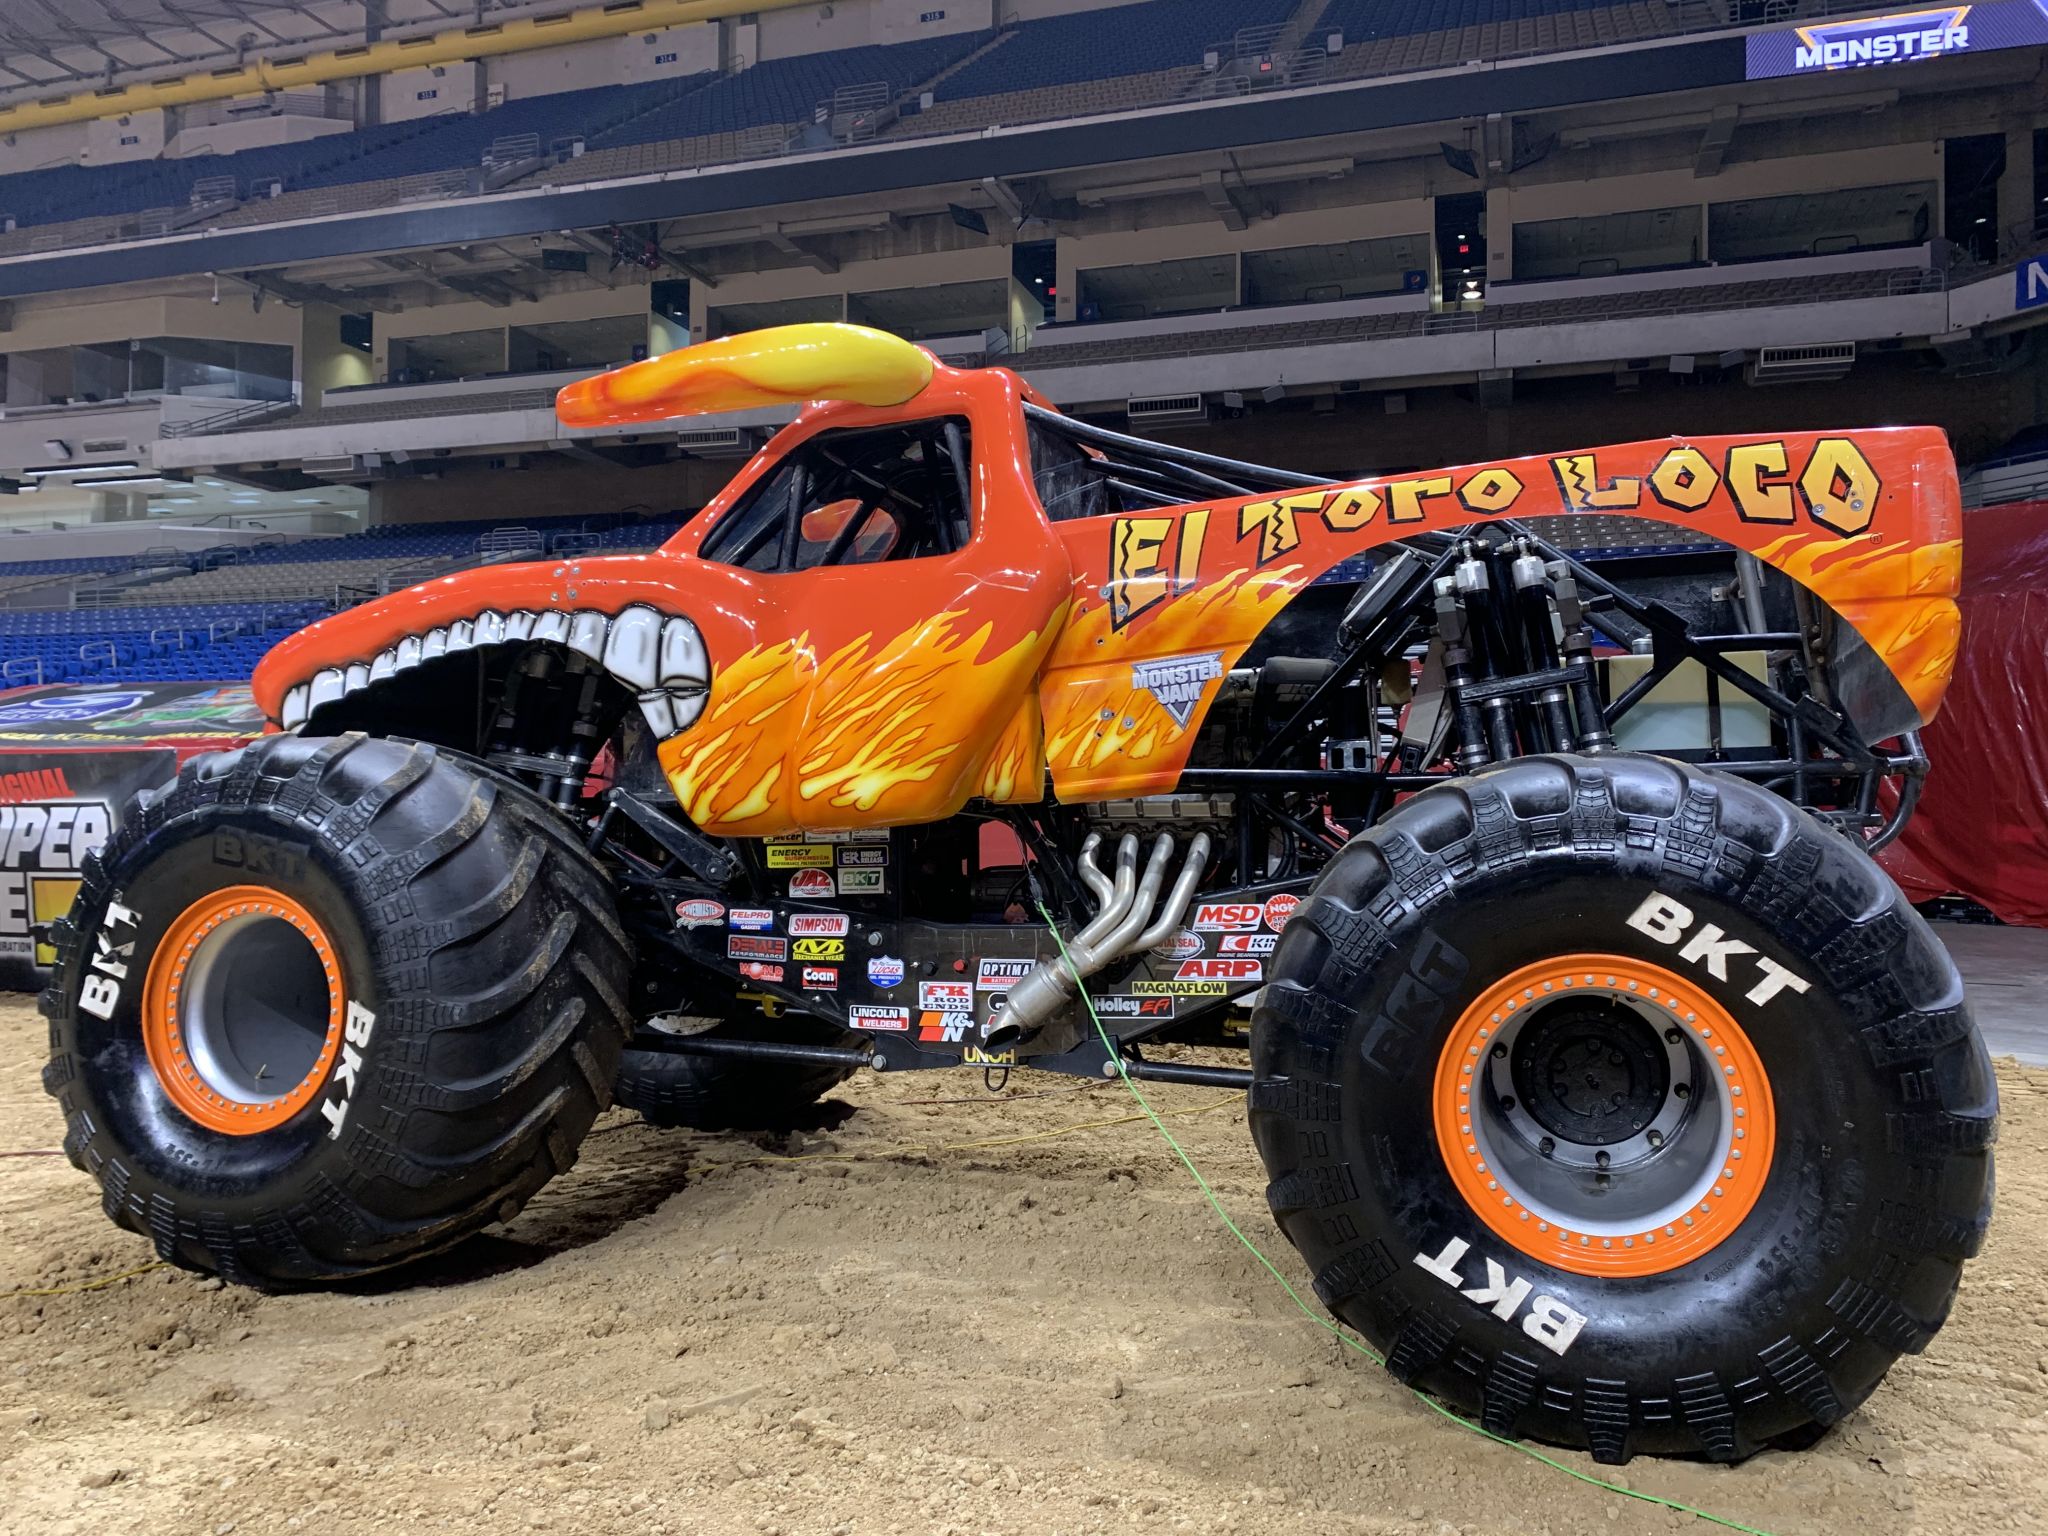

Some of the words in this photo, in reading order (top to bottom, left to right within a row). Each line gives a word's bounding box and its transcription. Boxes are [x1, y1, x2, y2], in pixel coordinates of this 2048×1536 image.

[1795, 26, 1970, 69] MONSTER
[1132, 660, 1223, 690] MONSTER
[1153, 681, 1202, 704] JAM
[212, 825, 310, 879] BKT
[792, 870, 831, 886] JAZ
[842, 871, 880, 886] BKT
[1198, 905, 1260, 922] MSD
[1270, 903, 1295, 914] NGK
[794, 918, 843, 932] SIMPSON
[731, 938, 784, 954] DERALE
[1178, 938, 1197, 948] SEAL
[1626, 890, 1811, 1007] BKT
[731, 951, 784, 959] PERFORMANCE
[739, 962, 784, 980] WORLD
[803, 968, 835, 981] Coan
[872, 966, 900, 974] LUCAS
[983, 963, 1030, 976] OPTIMA
[1178, 960, 1260, 977] ARP
[928, 986, 969, 996] FK
[1133, 983, 1225, 993] MAGNAFLOW
[922, 1003, 970, 1011] ENDS
[933, 996, 970, 1004] ROD
[1093, 997, 1140, 1016] Holley
[852, 1007, 899, 1019] LINCOLN
[862, 1018, 902, 1029] WELDERS
[318, 1000, 376, 1141] BKT
[1412, 1236, 1588, 1356] BKT
